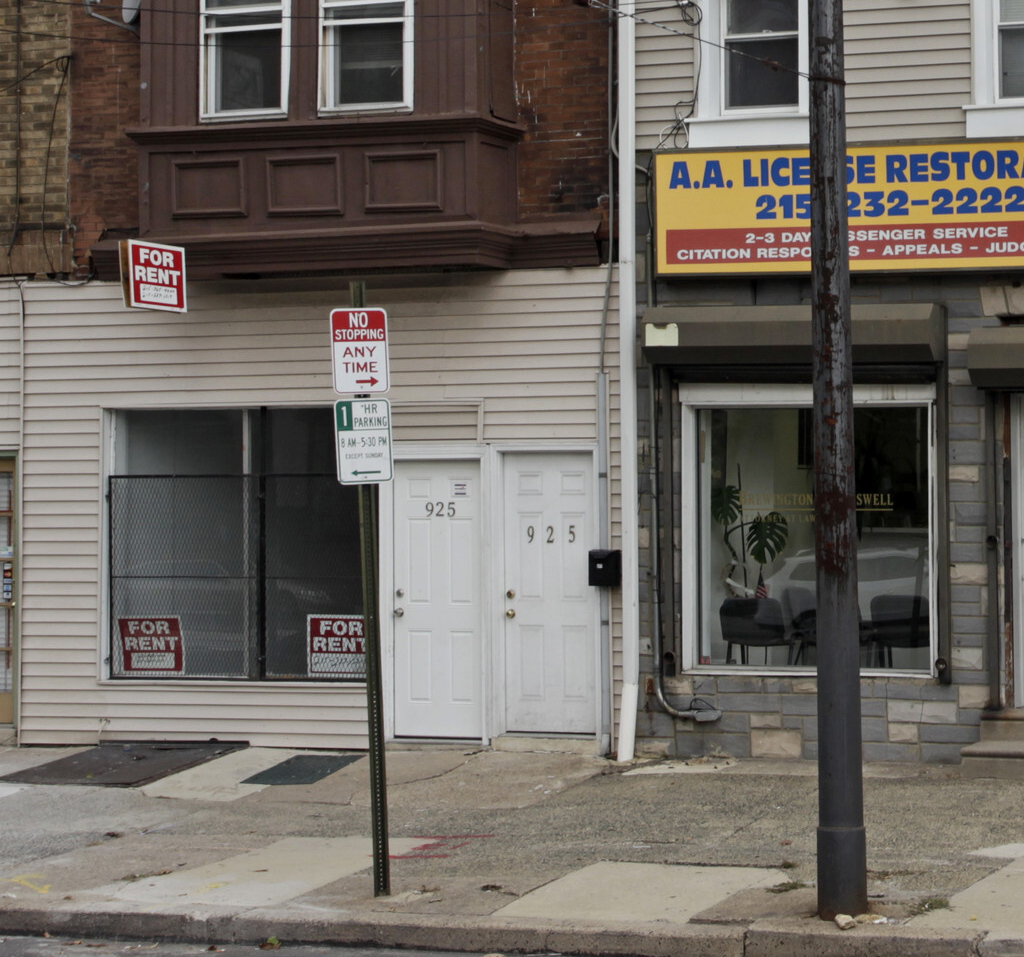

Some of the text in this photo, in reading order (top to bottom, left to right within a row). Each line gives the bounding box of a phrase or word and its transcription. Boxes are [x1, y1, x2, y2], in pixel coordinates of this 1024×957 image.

[669, 160, 733, 190] A.A.
[743, 155, 876, 187] LICESE
[745, 232, 775, 244] 2-3
[781, 231, 812, 243] DAY
[933, 226, 1008, 239] SERVICE
[139, 247, 175, 268] FOR
[676, 248, 751, 260] CITATION
[757, 245, 860, 260] RESPOS
[882, 242, 963, 256] APPEALS
[134, 265, 181, 286] RENT
[349, 312, 369, 328] NO
[335, 328, 384, 341] STOPPING
[343, 346, 377, 358] ANY
[343, 362, 379, 373] TIME
[341, 404, 378, 427] 1 HR
[354, 416, 388, 428] PARKING
[378, 436, 388, 446] PM
[425, 501, 456, 518] 925
[127, 620, 171, 635] FOR
[319, 620, 363, 636] FOR
[124, 636, 180, 651] RENT
[312, 636, 366, 652] RENT
